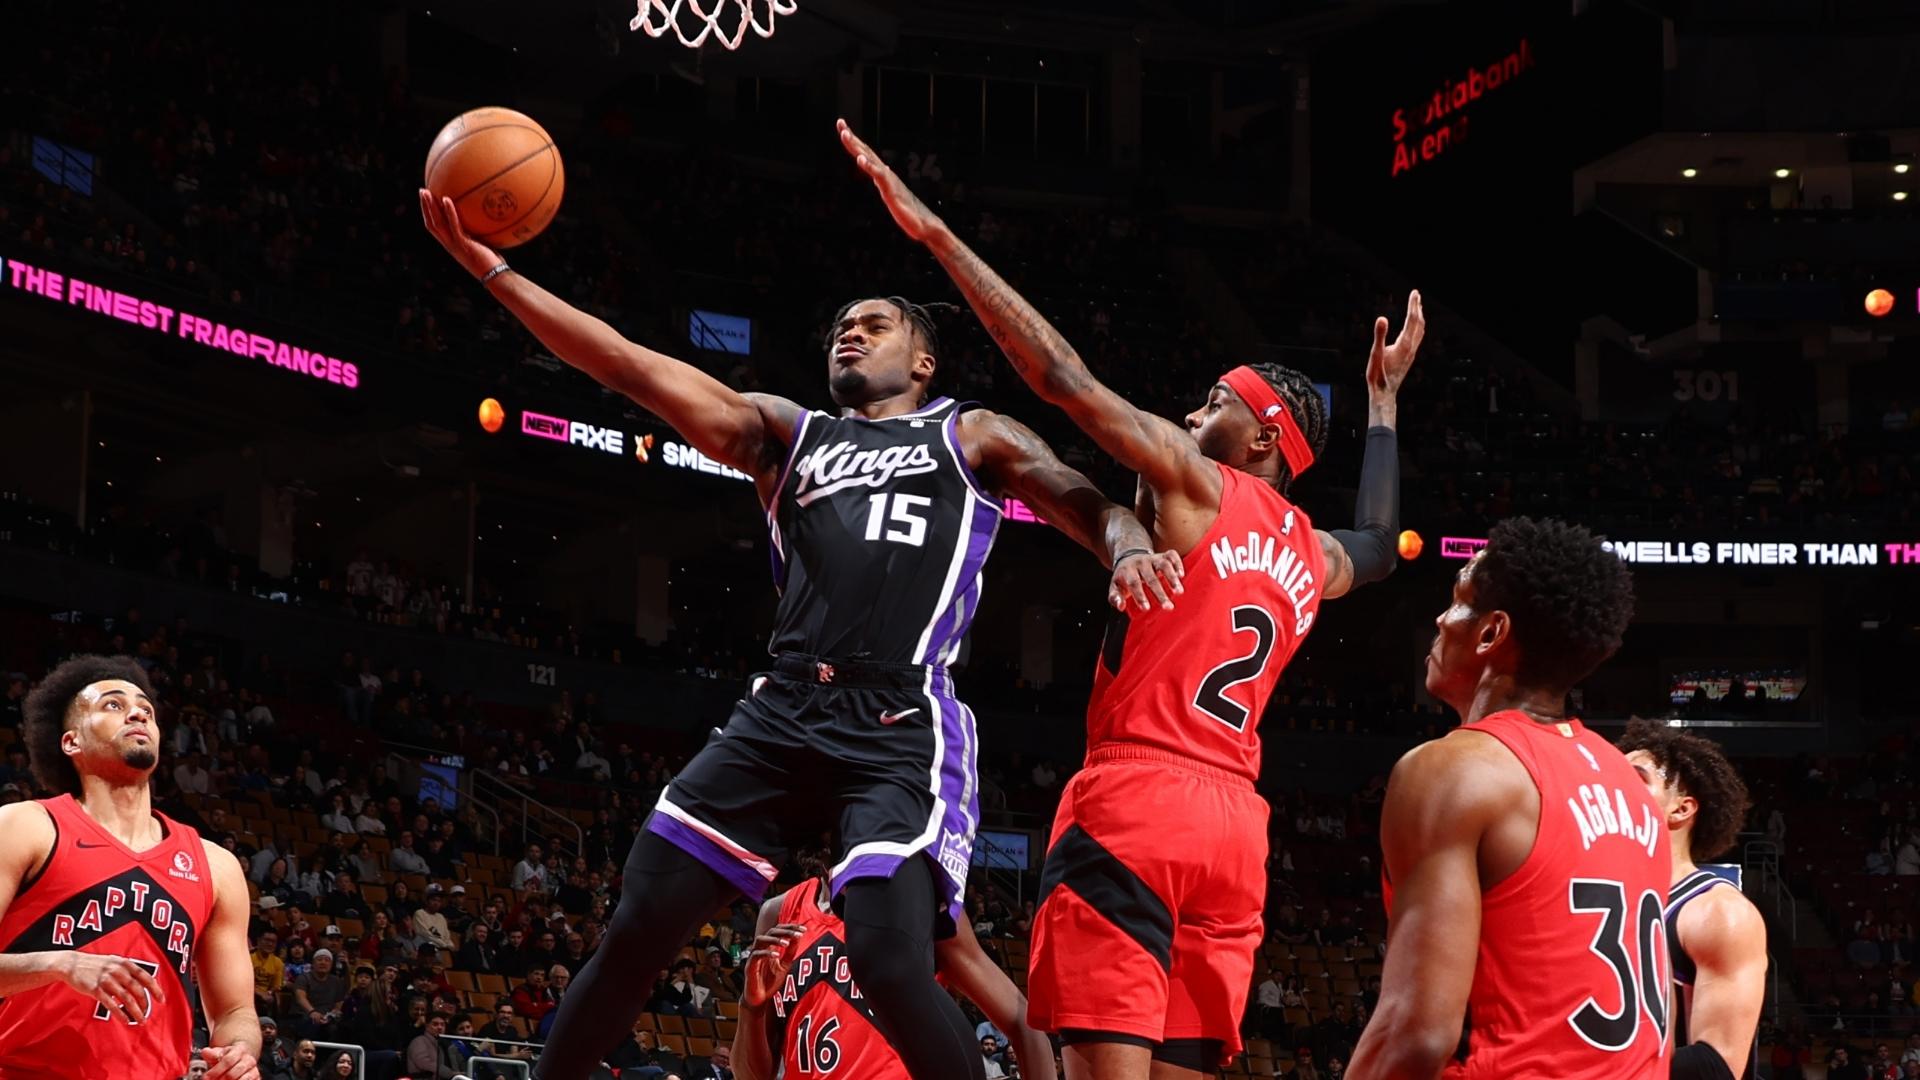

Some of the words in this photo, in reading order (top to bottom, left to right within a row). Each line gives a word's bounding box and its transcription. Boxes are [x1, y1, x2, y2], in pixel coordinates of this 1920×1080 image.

[1392, 37, 1537, 142] Sotiabank
[8, 259, 63, 301] THE
[68, 278, 174, 334] FINEST
[179, 312, 359, 389] FRAGRANCES
[1672, 369, 1739, 402] 301
[525, 417, 566, 437] NEW
[570, 421, 623, 455] AXE
[663, 441, 754, 482] SMELL
[796, 441, 938, 500] Kings
[865, 493, 931, 547] 15
[1717, 542, 1797, 564] FINER
[1804, 543, 1878, 565] THAN
[1210, 531, 1316, 636] McDANIELS
[527, 663, 556, 686] 121
[1192, 604, 1277, 734] 2
[1568, 783, 1659, 858] AGBAJI
[53, 881, 189, 974] RAPTORS
[773, 946, 873, 1018] RAPTO
[1567, 878, 1671, 1058] 30
[797, 1014, 841, 1075] 16
